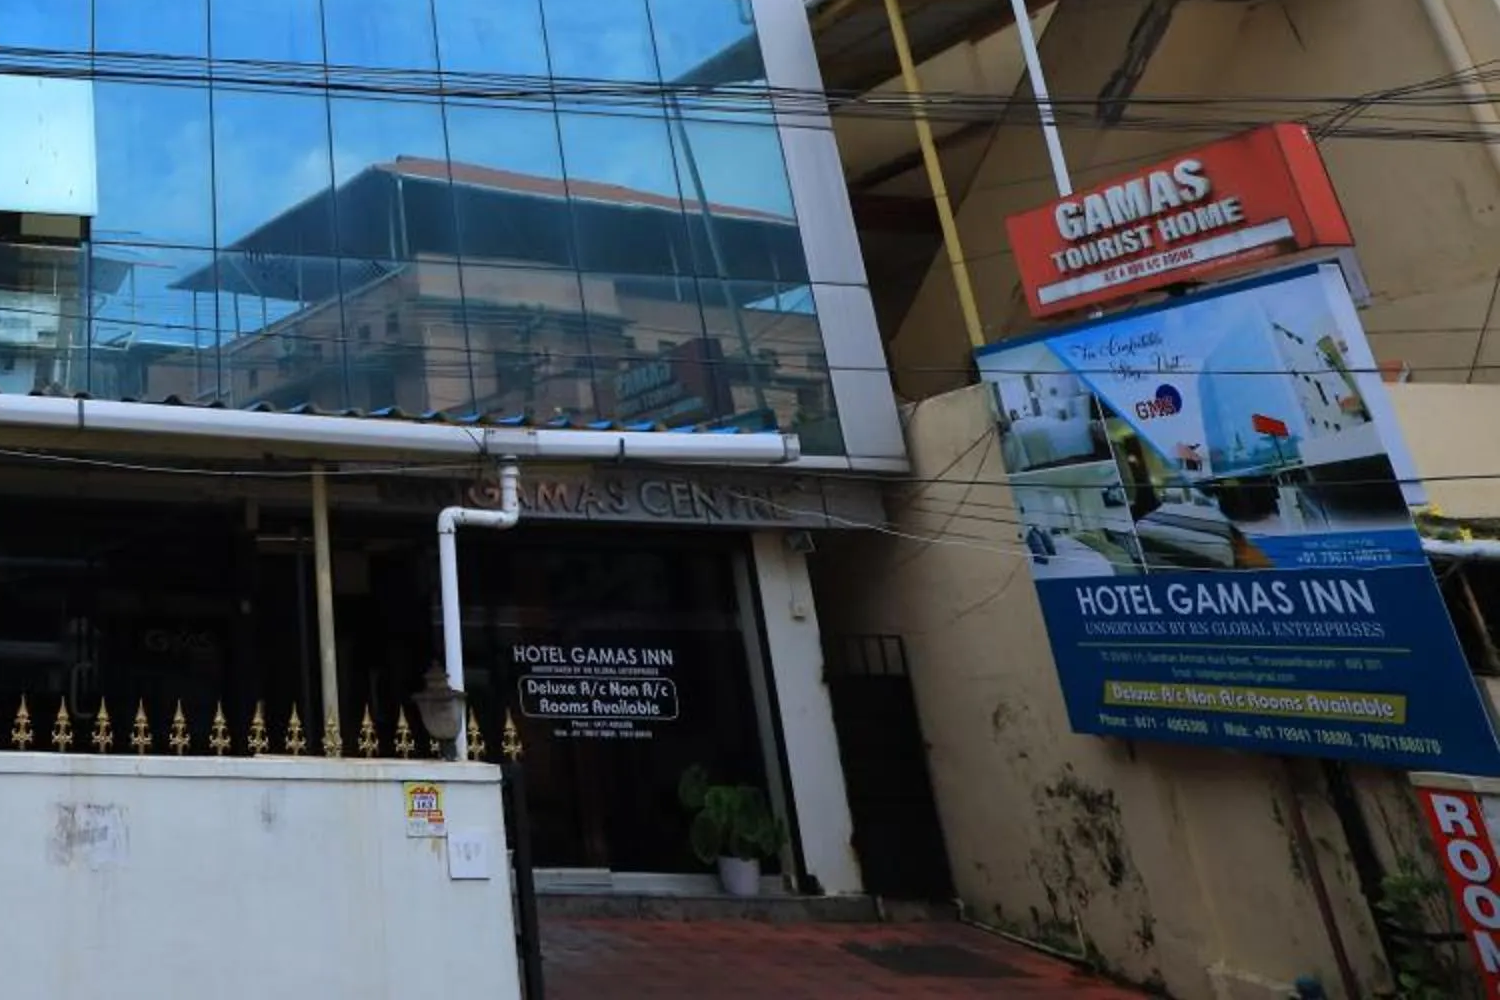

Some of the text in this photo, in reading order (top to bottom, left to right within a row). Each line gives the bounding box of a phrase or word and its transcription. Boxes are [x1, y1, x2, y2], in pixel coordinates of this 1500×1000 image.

[1054, 158, 1211, 241] GAMAS
[1051, 226, 1153, 274] TOURIST
[1158, 196, 1244, 244] HOME
[1076, 578, 1376, 616] HOTEL GAMAS INN
[1085, 621, 1167, 636] UNDERTAKEN
[1168, 621, 1187, 636] BY
[1211, 621, 1271, 637] GLOBAL
[1272, 621, 1386, 639] ENTERPRISES
[513, 645, 674, 666] HOTEL GAMAS INN
[527, 679, 577, 695] Deluxe
[609, 681, 639, 696] Non
[1112, 683, 1159, 701] Deluxe
[1248, 691, 1303, 711] Rooms
[1306, 694, 1395, 718] Available
[539, 697, 661, 715] Rooms Available
